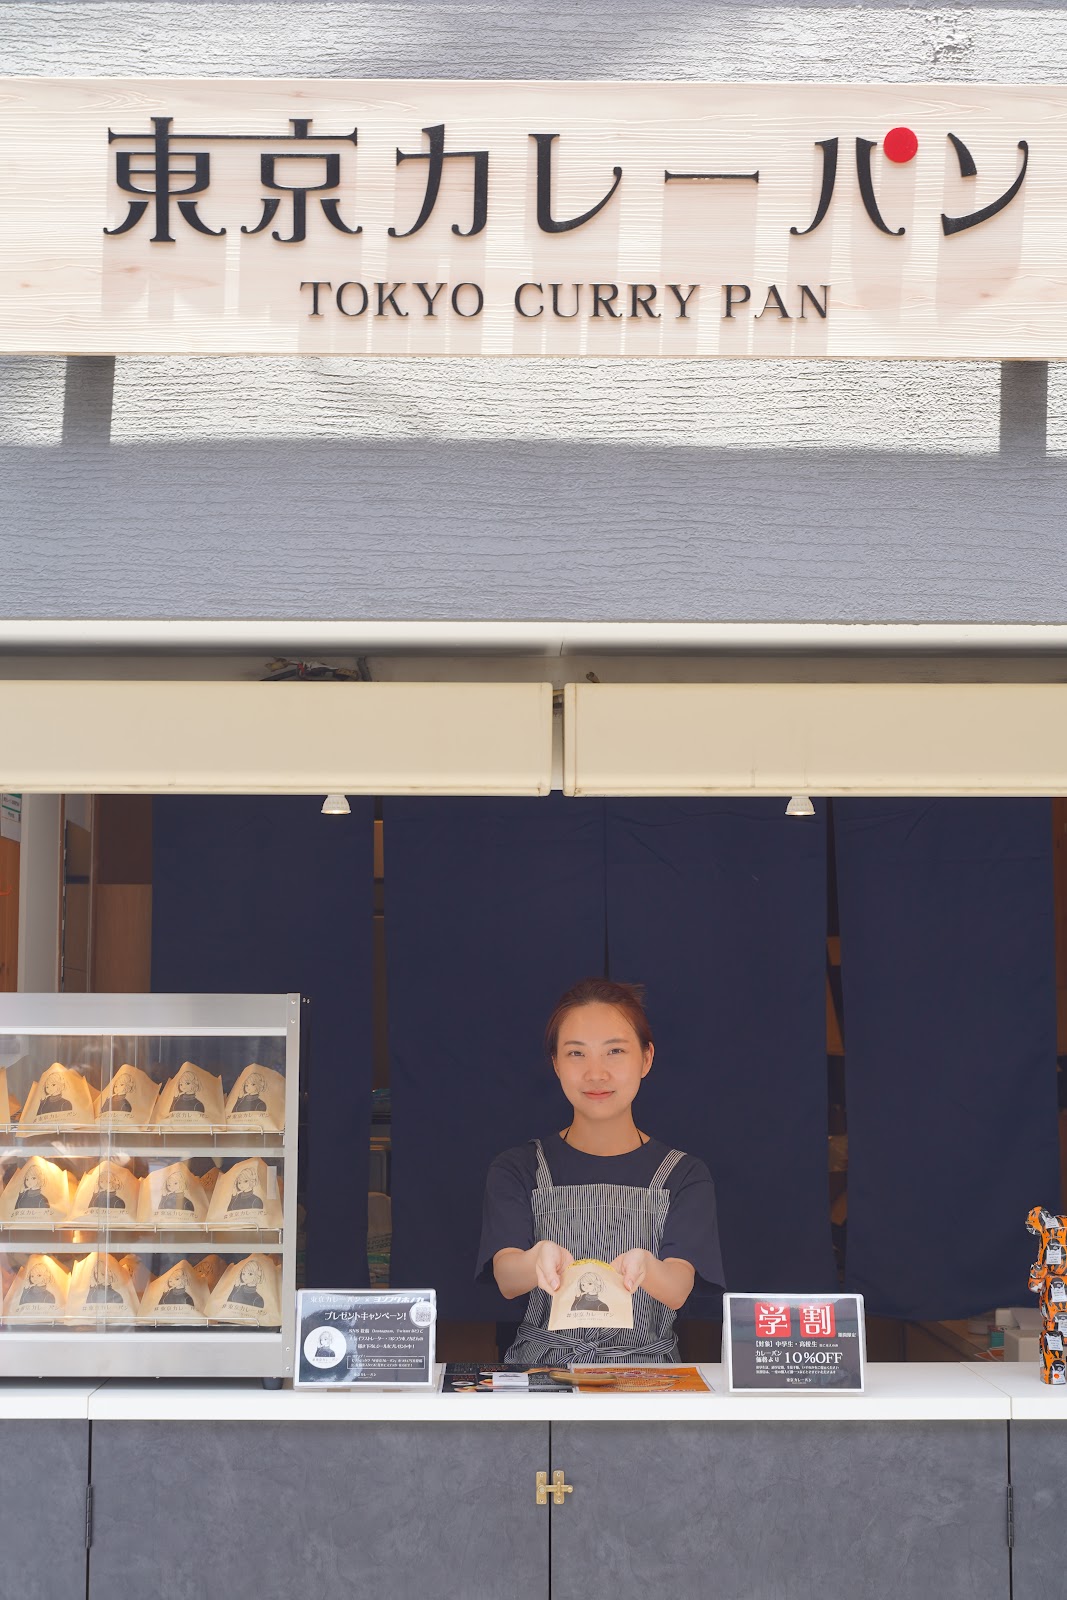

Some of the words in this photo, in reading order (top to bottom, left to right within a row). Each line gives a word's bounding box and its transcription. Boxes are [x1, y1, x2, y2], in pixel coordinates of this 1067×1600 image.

[103, 116, 1029, 242] 東京カレーパン
[299, 281, 485, 317] TOKYO
[514, 282, 700, 318] CURRY
[721, 284, 831, 319] PAN
[785, 1352, 843, 1364] 10%OFF
